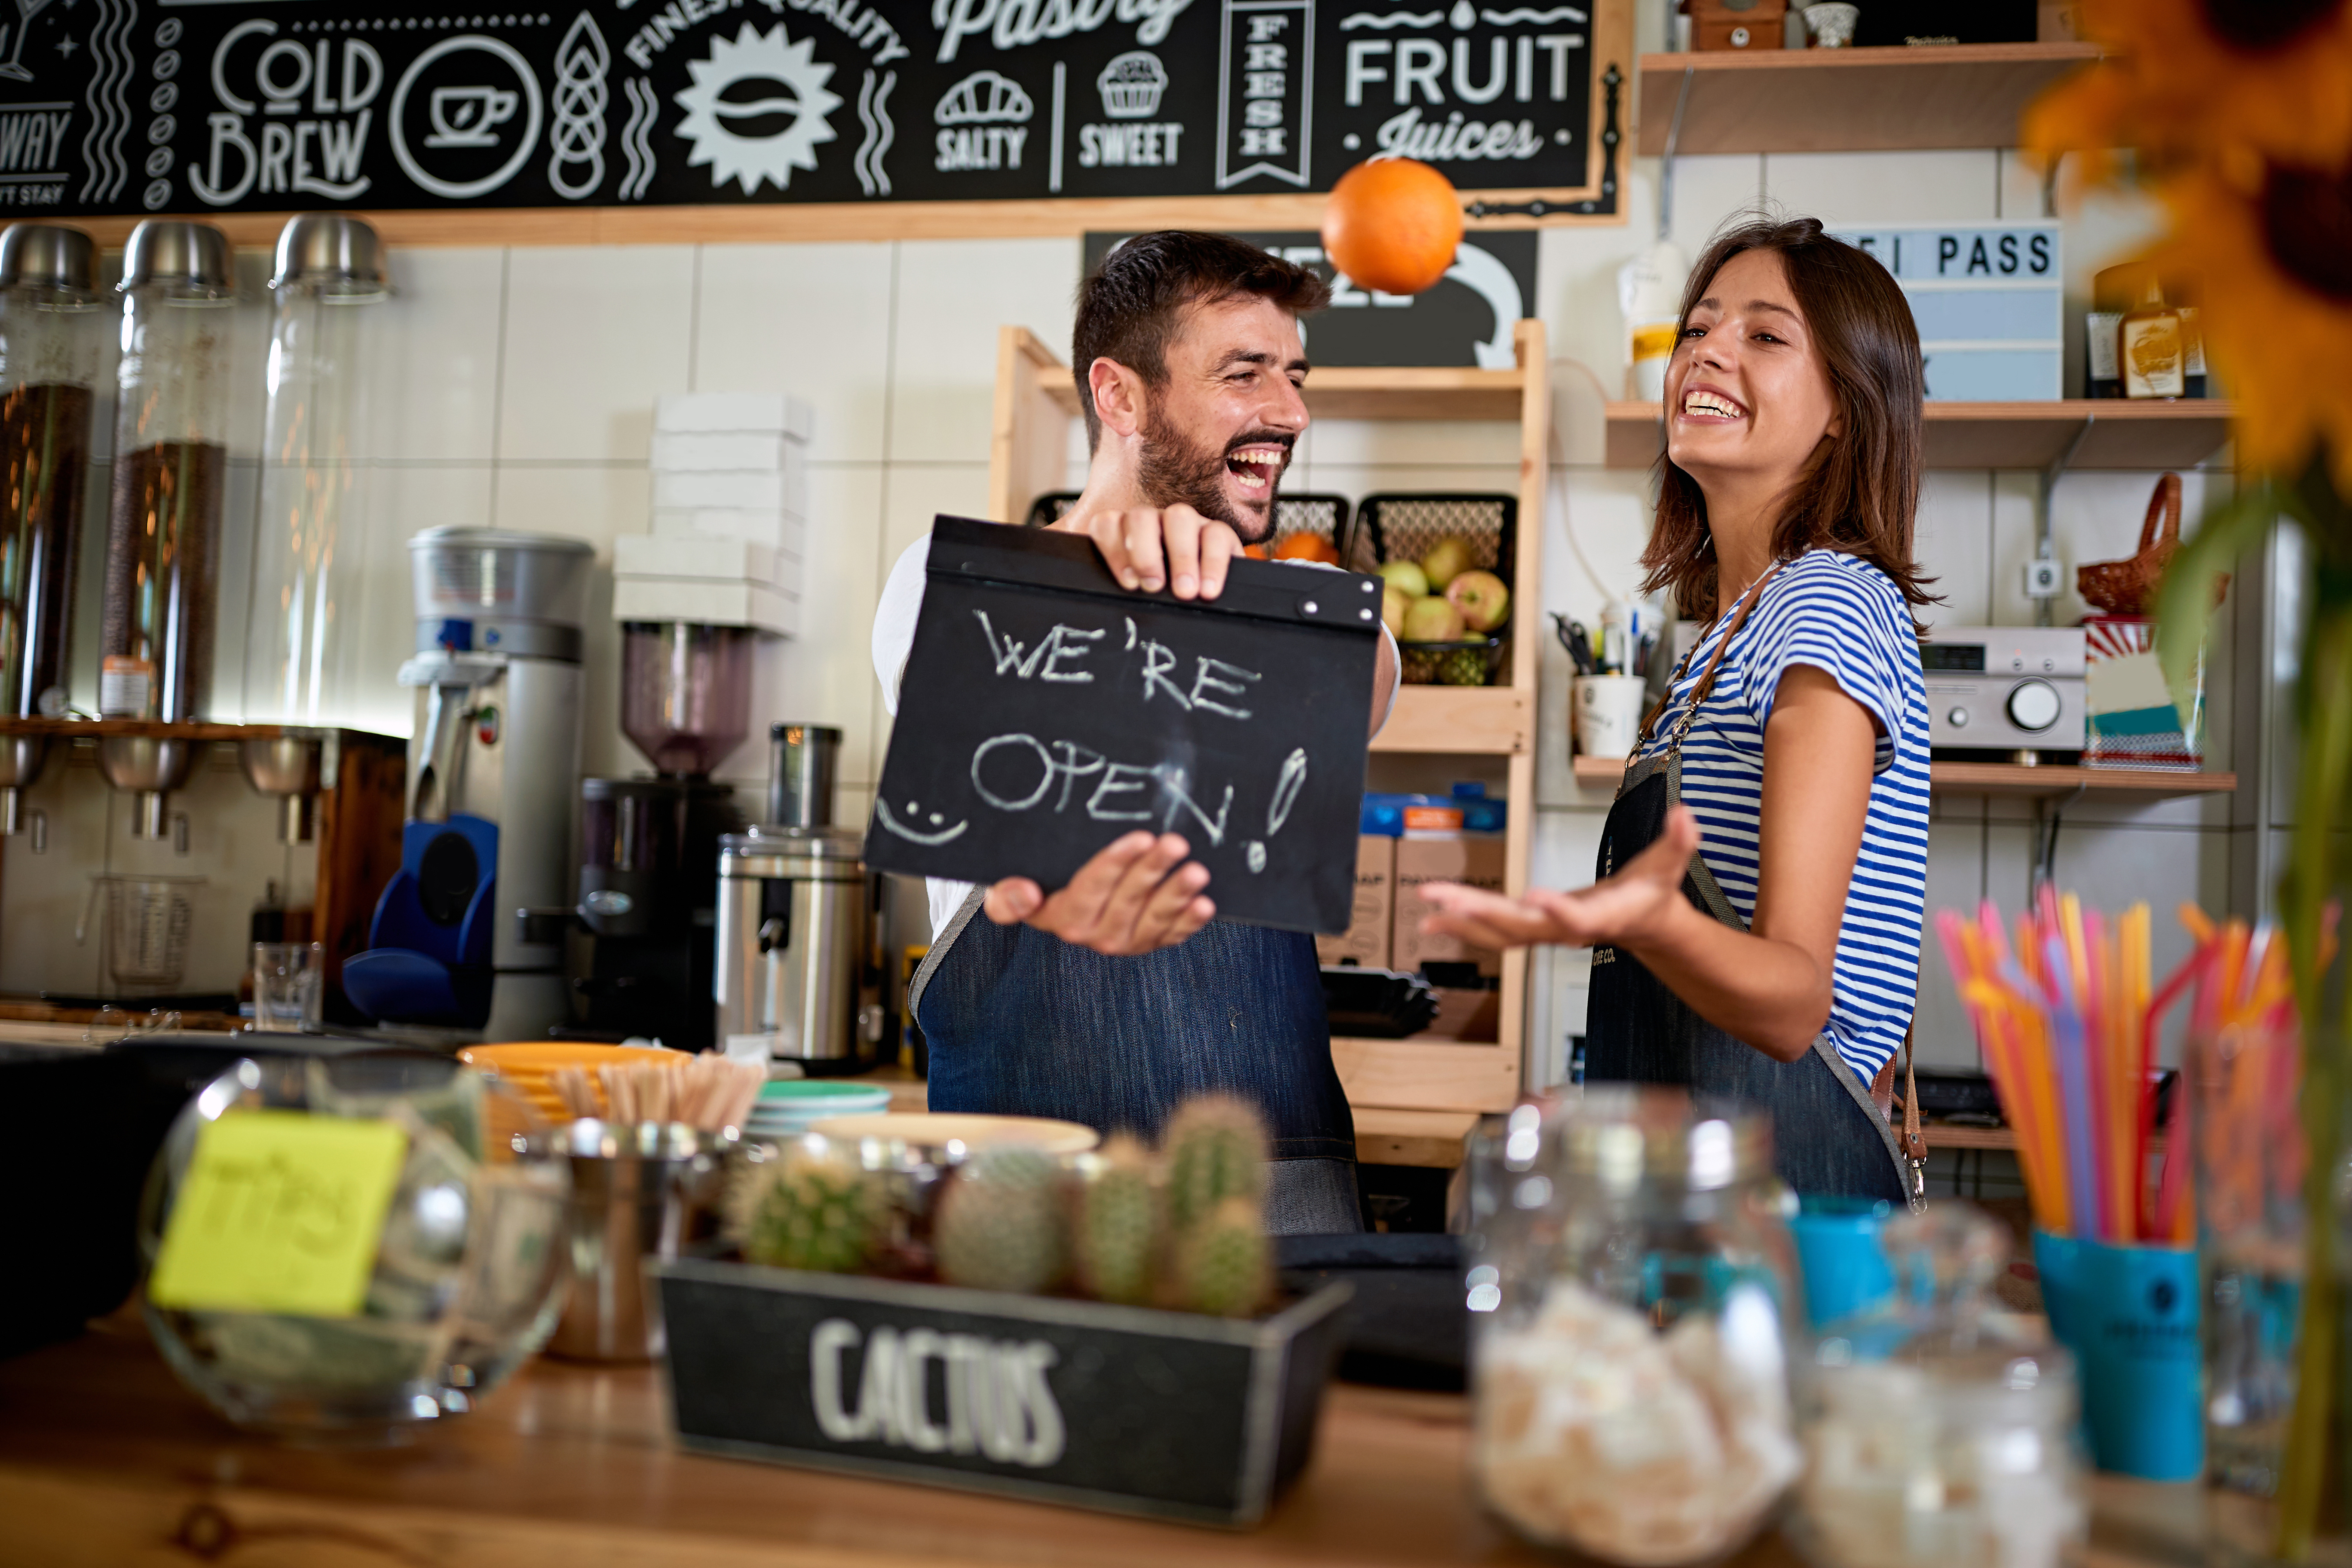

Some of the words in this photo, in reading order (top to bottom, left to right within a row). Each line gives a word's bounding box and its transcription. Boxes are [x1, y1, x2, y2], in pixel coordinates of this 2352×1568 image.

[210, 19, 383, 115] COLD
[624, 0, 741, 70] FINE
[759, 0, 911, 66] ALITY
[1345, 34, 1584, 106] FRUIT
[1240, 15, 1288, 156] FRESH
[188, 107, 372, 206] BREW
[935, 127, 1028, 171] SALTY
[1078, 122, 1184, 167] SWEET
[1365, 106, 1544, 166] Juices
[19, 184, 65, 206] STAY
[1938, 232, 2052, 276] PASS
[973, 609, 1262, 719] WE'RE
[971, 732, 1307, 874] OPEN!
[810, 1317, 1068, 1468] CACTUS
